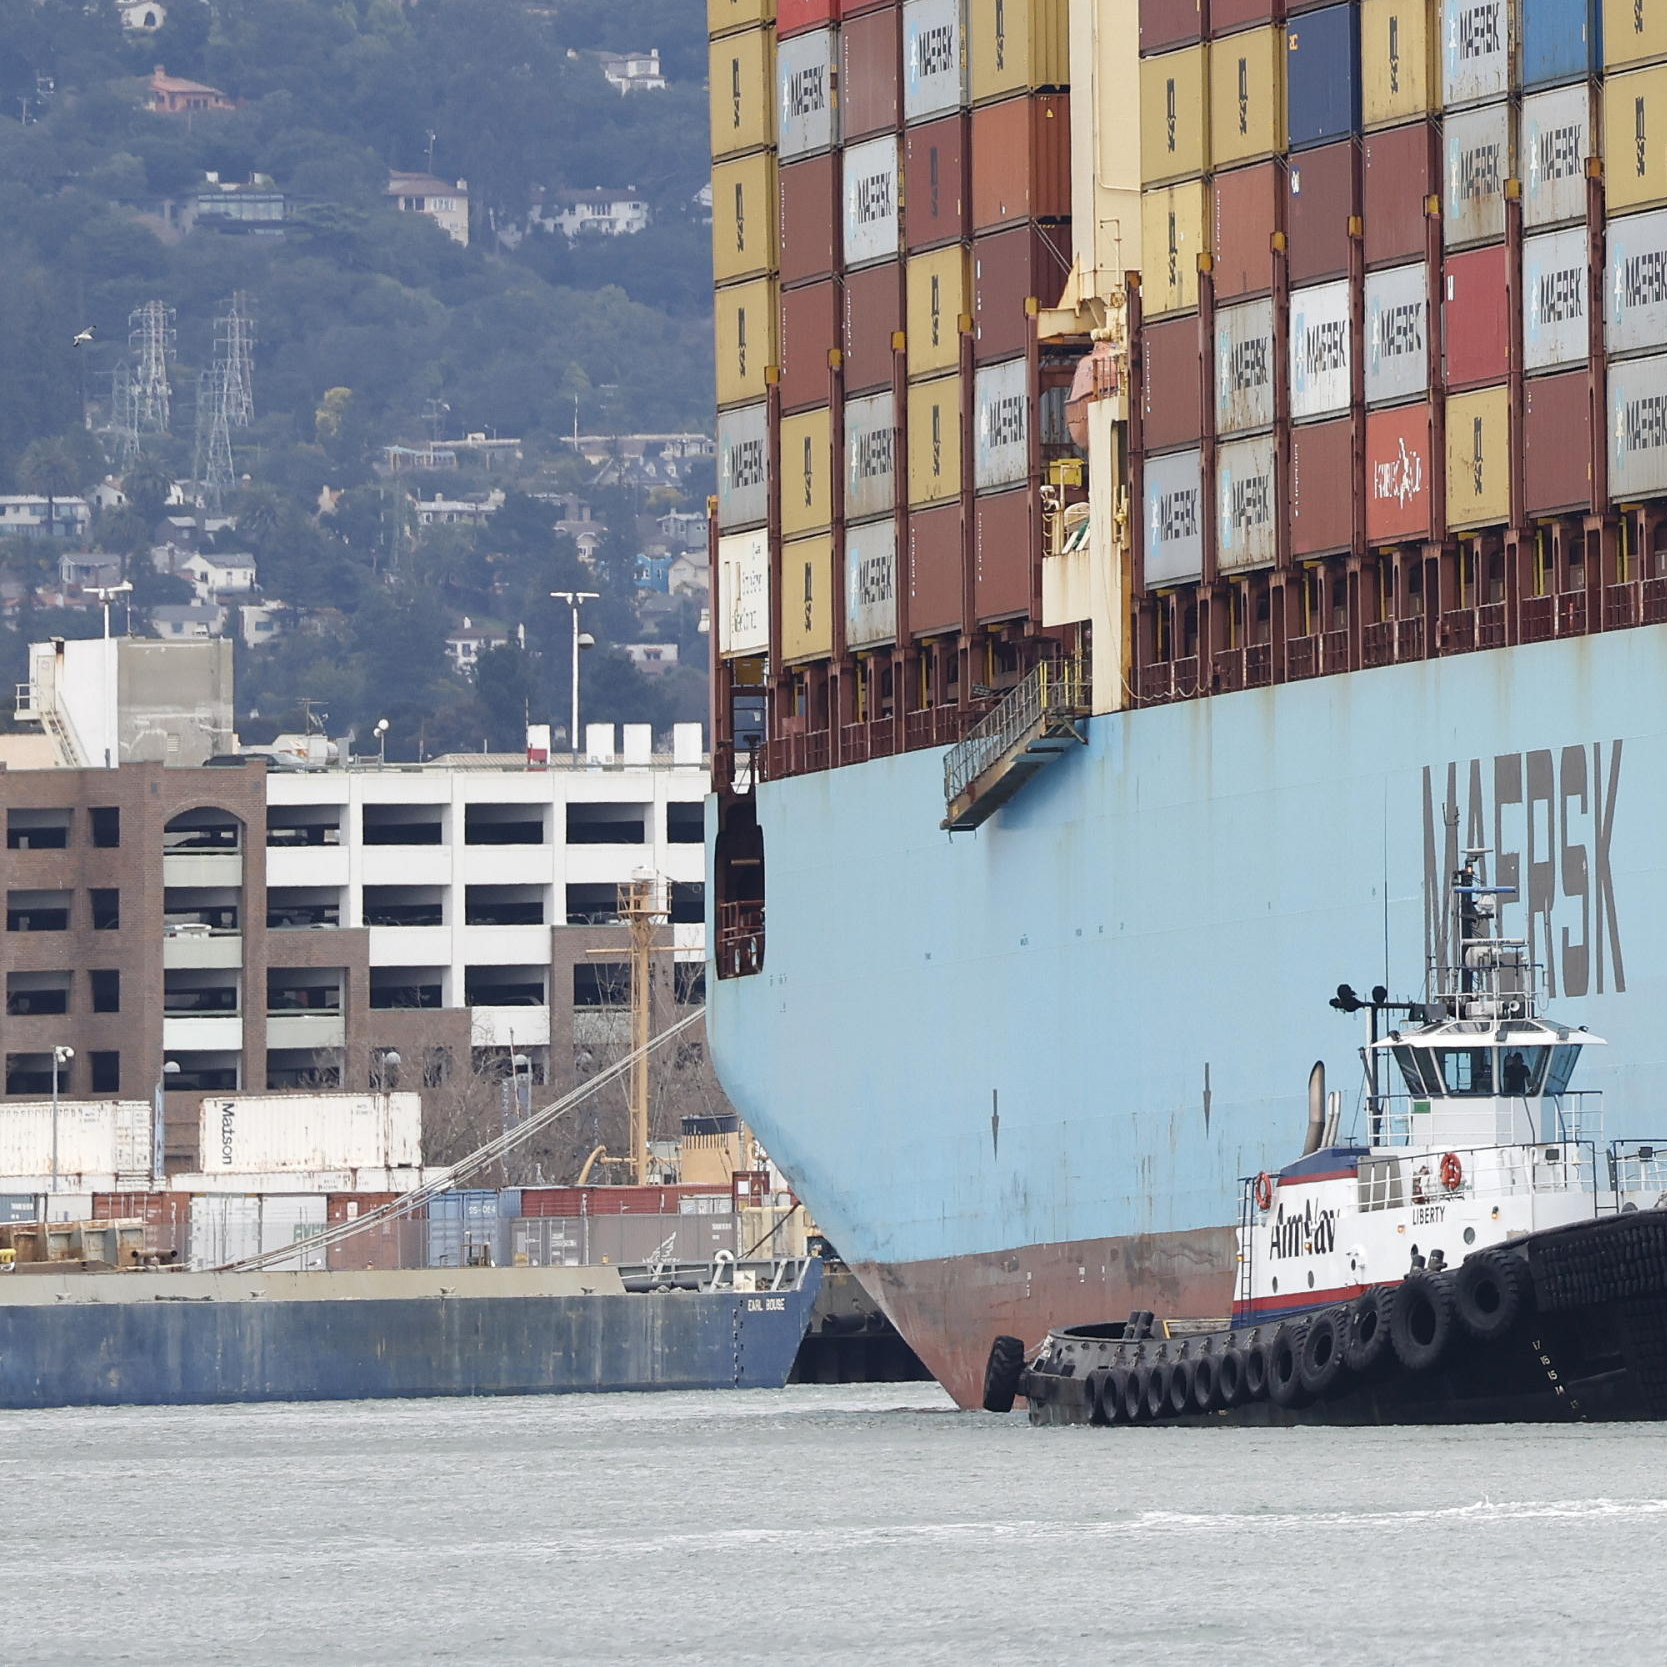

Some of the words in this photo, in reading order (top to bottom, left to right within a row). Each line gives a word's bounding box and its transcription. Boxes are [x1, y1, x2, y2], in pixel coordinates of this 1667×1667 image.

[919, 25, 953, 77] MAERSK
[1460, 2, 1500, 58] MAERSK
[1460, 144, 1501, 201] MAERSK
[1541, 125, 1581, 182] MAERSK
[858, 173, 891, 223] MAERSK
[1541, 268, 1582, 323] MAERSK
[1626, 251, 1667, 307] MAERSK
[1382, 303, 1421, 357] MAERSK
[1231, 338, 1268, 396] MAERSK
[1627, 396, 1667, 450] MAERSK
[860, 429, 892, 477] MAERSK
[1161, 489, 1197, 540] MAERSK
[1233, 475, 1268, 531] MAERSK
[860, 556, 892, 604] MAERSK
[221, 1103, 235, 1165] Matson
[1412, 1206, 1446, 1226] LIBERTY
[1540, 1355, 1550, 1365] 16
[1548, 1370, 1558, 1381] 15
